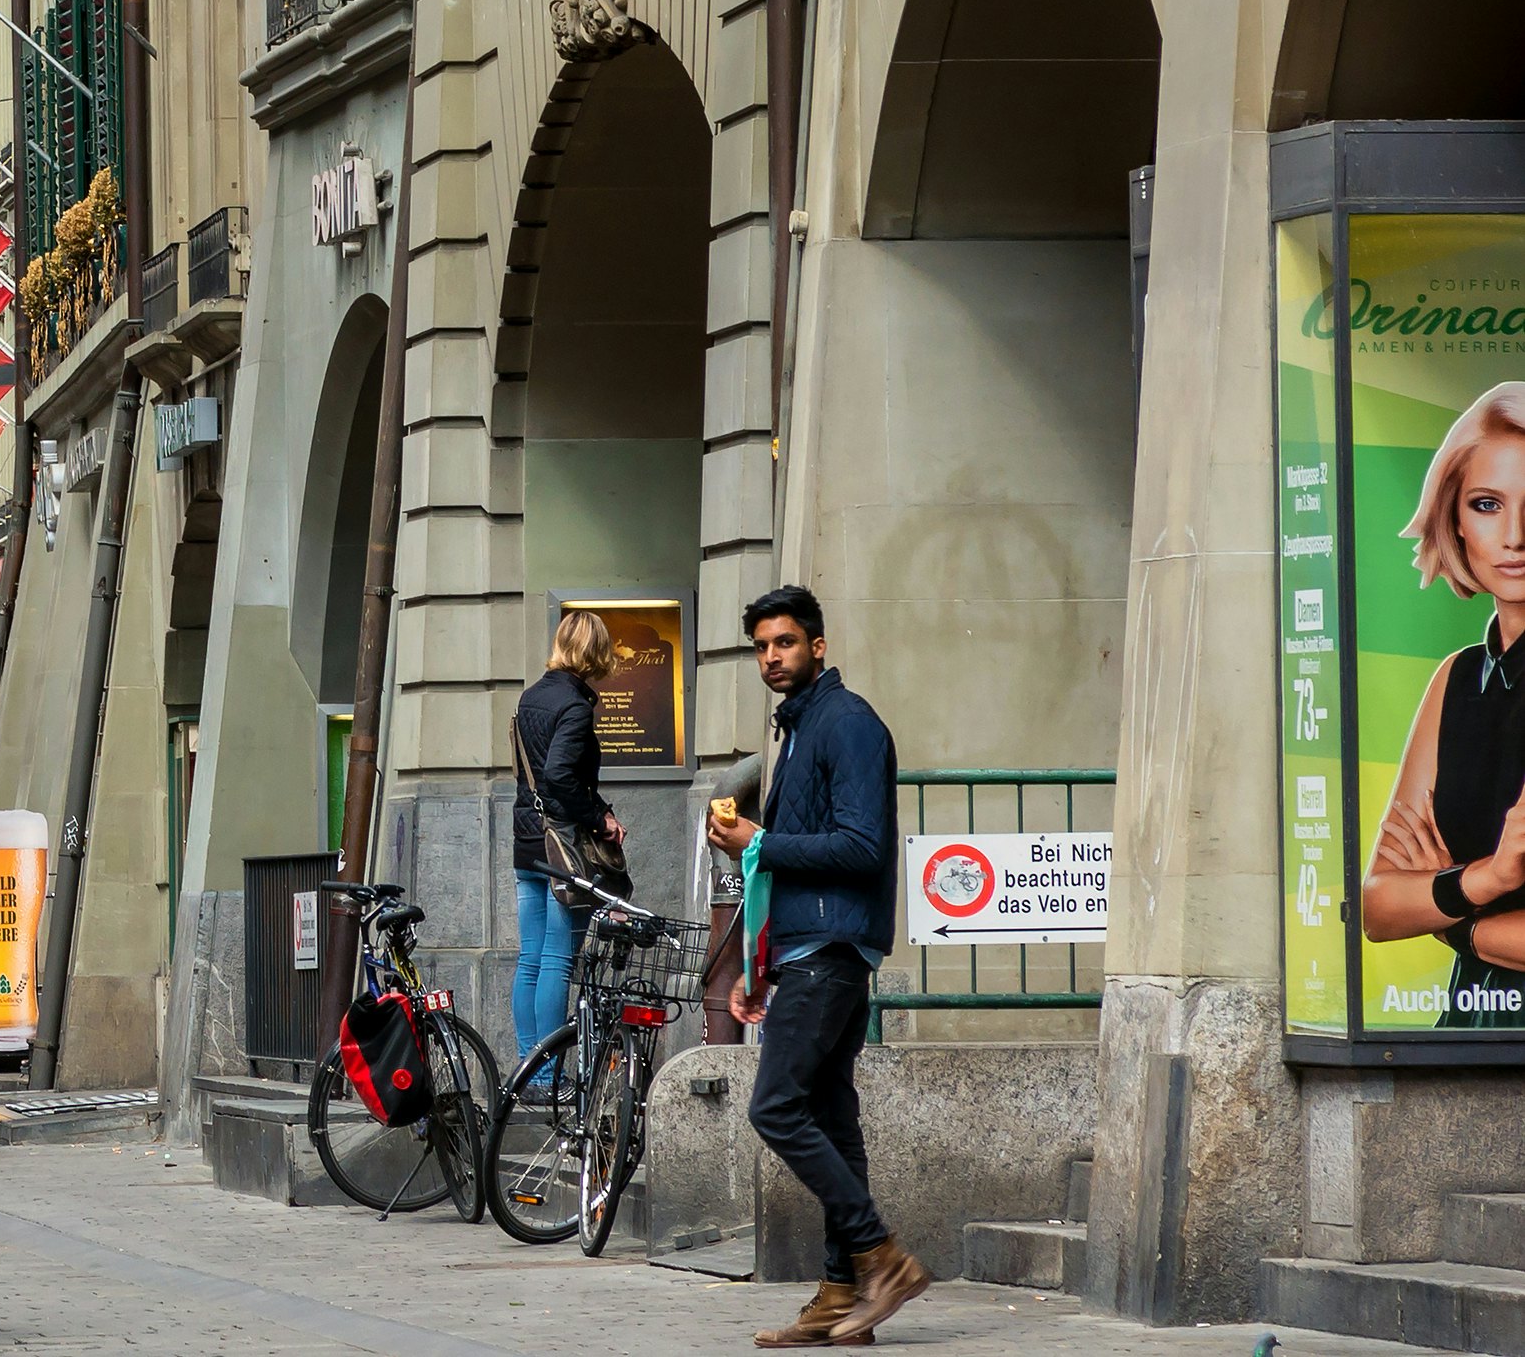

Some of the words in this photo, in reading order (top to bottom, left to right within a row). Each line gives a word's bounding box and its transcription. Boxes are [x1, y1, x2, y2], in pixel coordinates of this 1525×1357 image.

[312, 157, 362, 246] BONITA
[1358, 340, 1415, 353] AMEN
[1424, 340, 1435, 353] &
[1444, 340, 1525, 353] HERREN
[1298, 598, 1321, 623] Damen
[636, 651, 665, 667] Thai
[1300, 784, 1324, 809] Herren
[1031, 843, 1061, 863] Bei
[1005, 869, 1106, 891] beachtung
[998, 895, 1032, 913] das
[1038, 894, 1078, 913] Velo
[1085, 897, 1108, 912] en
[1382, 984, 1451, 1012] Auch
[1457, 984, 1522, 1012] ohne
